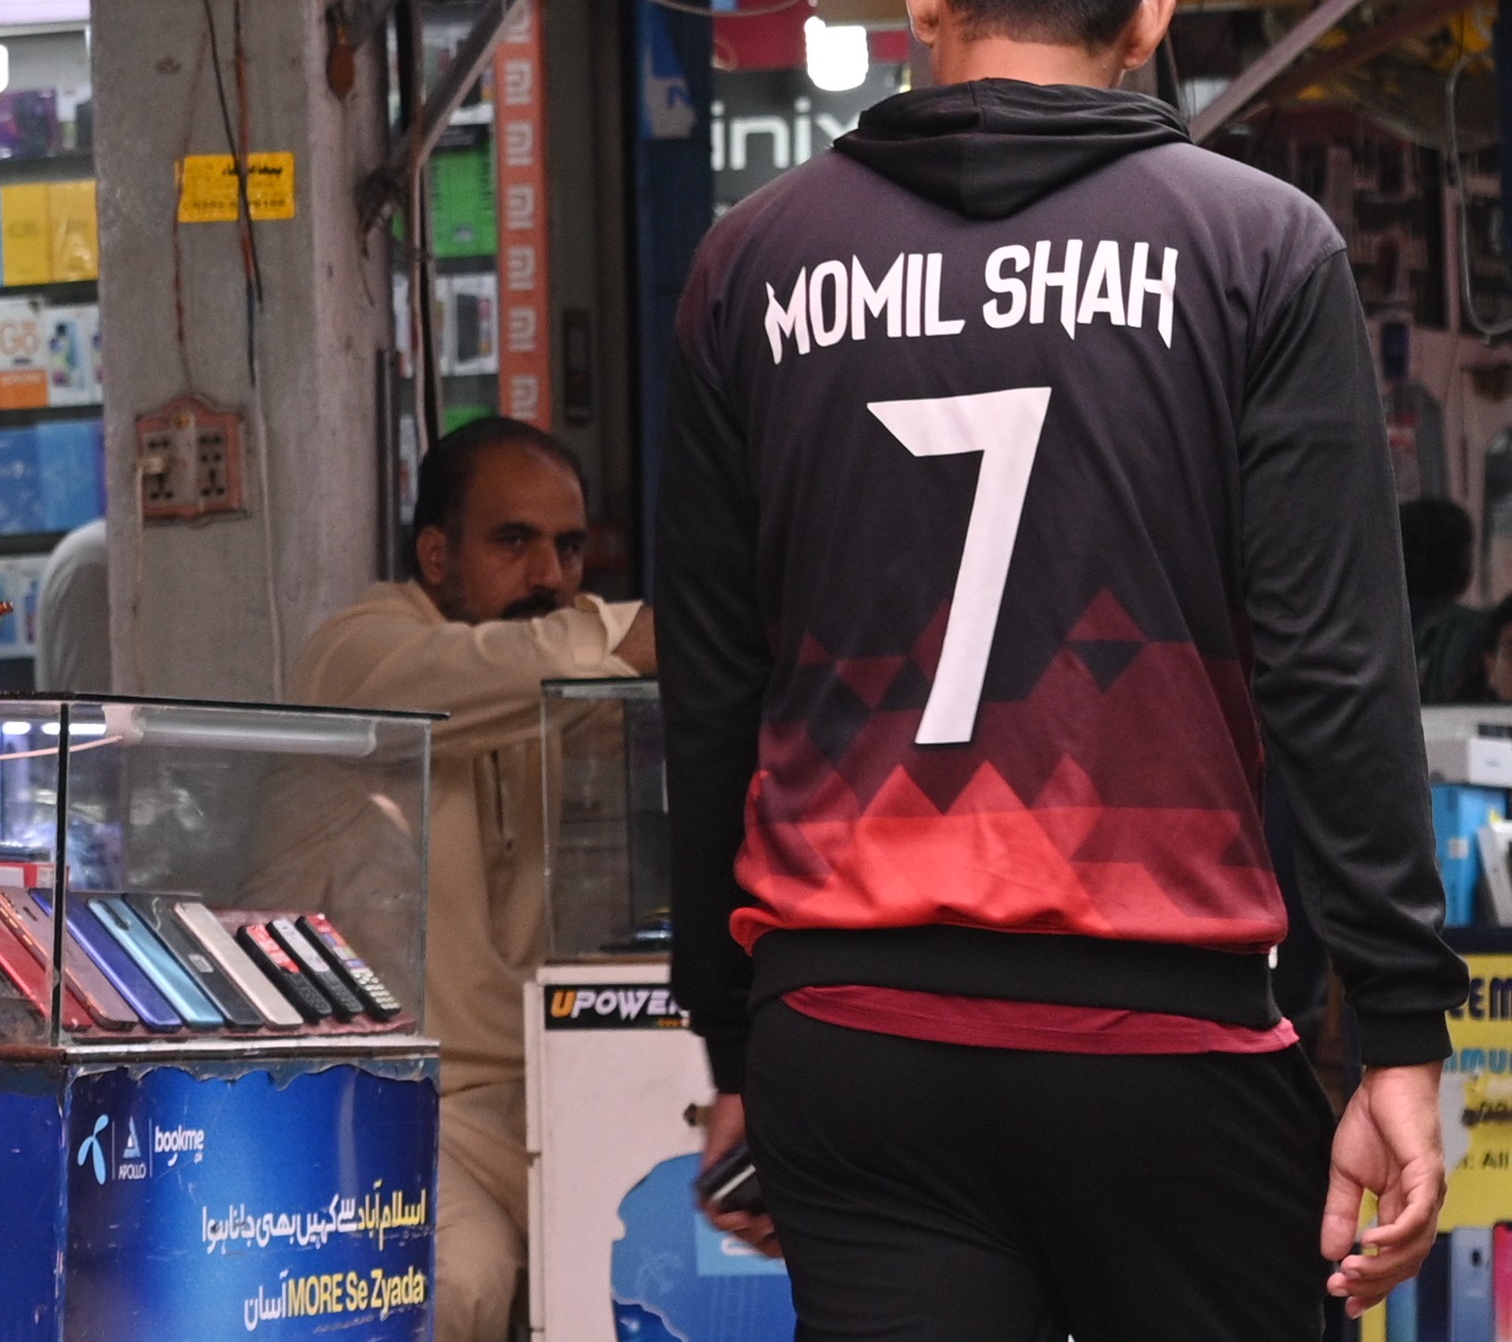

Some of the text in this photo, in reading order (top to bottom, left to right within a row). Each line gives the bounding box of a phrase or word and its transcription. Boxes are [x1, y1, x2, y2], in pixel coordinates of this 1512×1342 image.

[765, 239, 1180, 365] MOMIL SHAH
[866, 385, 1052, 745] 7
[117, 1164, 147, 1181] APOLLO
[155, 1125, 205, 1167] bookme
[243, 1266, 426, 1332] MORE Se Zyada آسان
